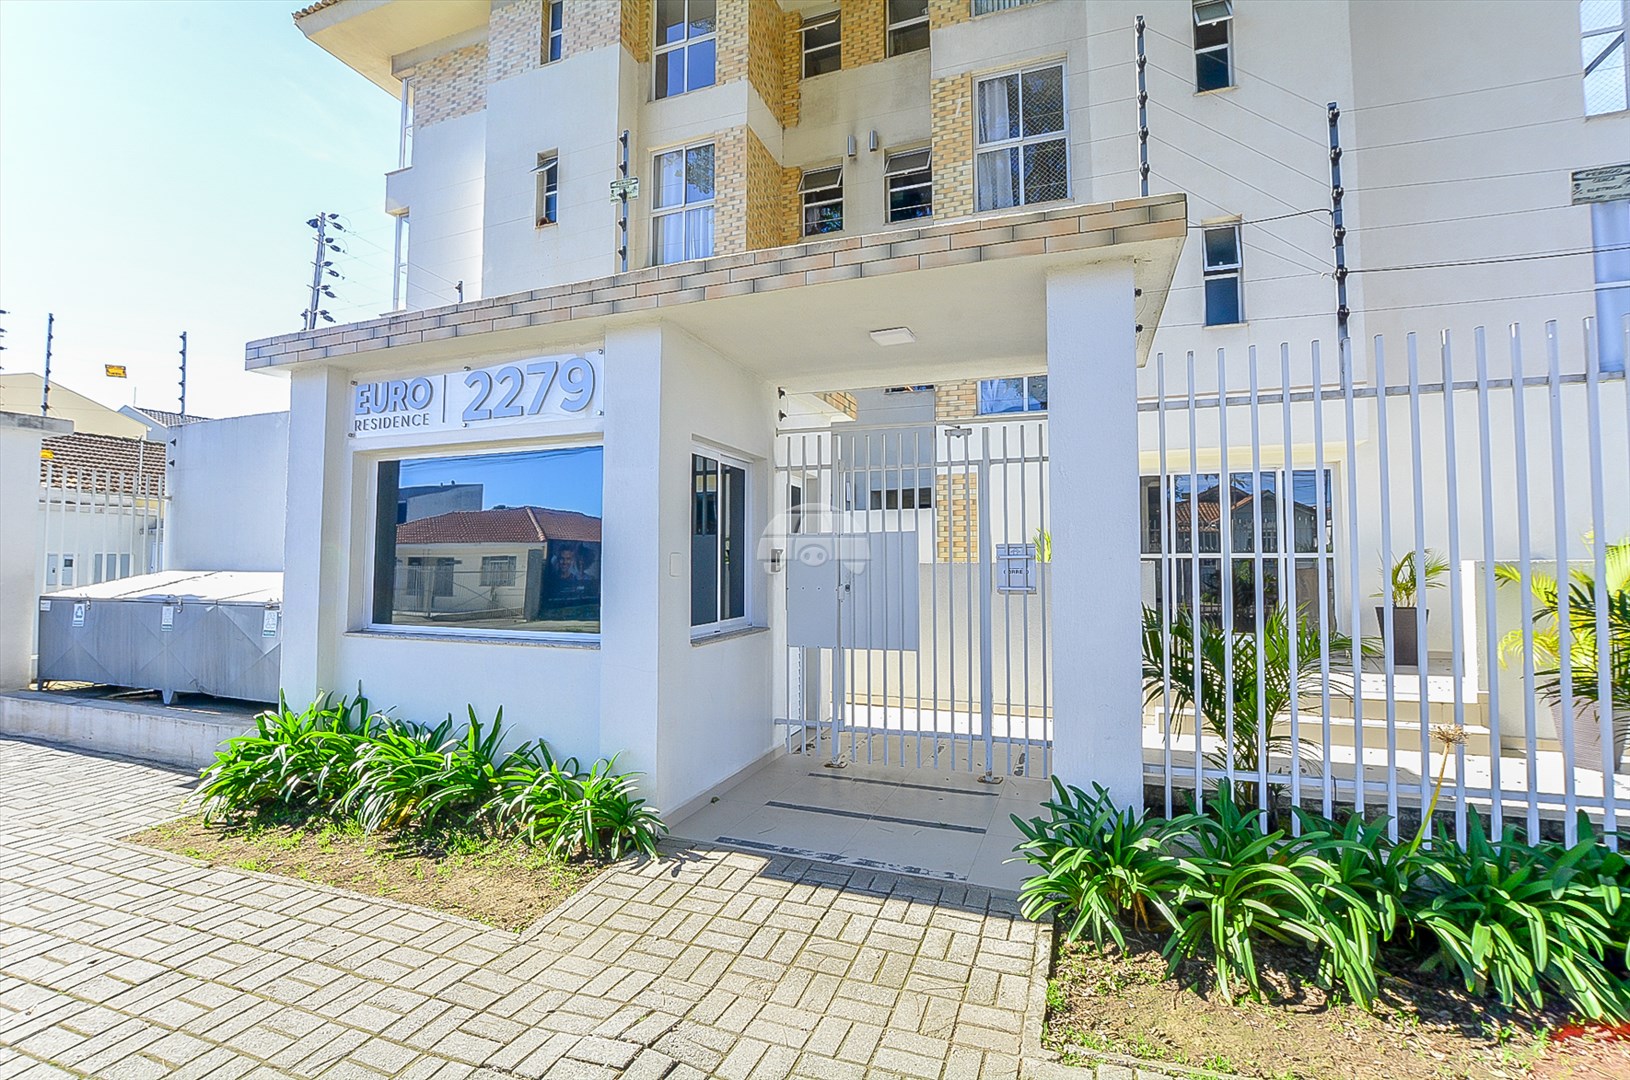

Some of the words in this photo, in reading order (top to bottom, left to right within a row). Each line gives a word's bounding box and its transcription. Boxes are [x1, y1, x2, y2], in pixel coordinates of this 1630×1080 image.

[355, 377, 433, 415] EURO
[462, 358, 595, 422] 2279
[354, 412, 430, 432] RESIDENCE
